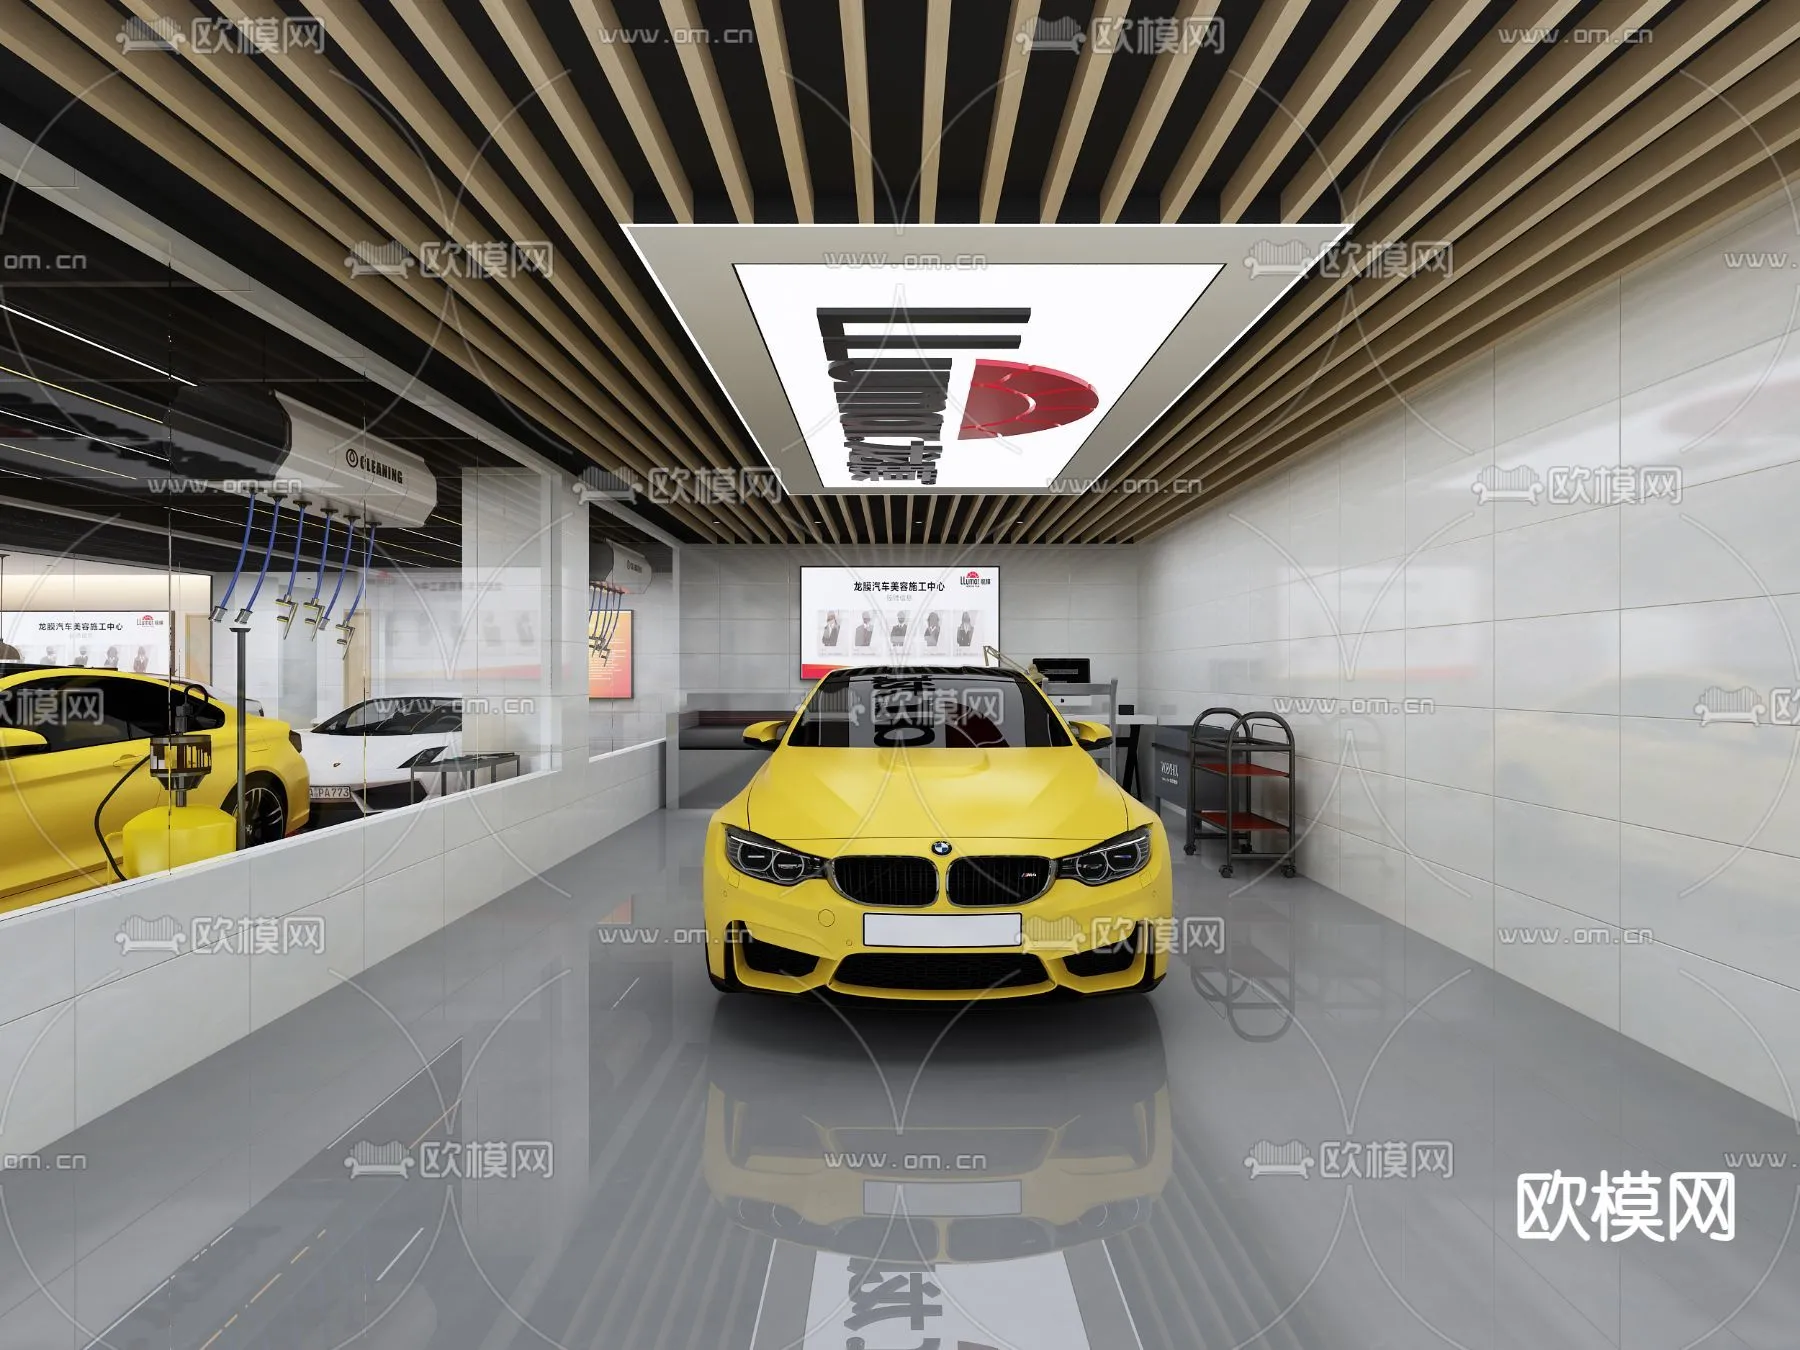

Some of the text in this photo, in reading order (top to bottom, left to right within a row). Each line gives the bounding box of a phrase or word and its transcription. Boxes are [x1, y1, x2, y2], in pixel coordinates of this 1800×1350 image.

[360, 456, 403, 484] CLEANING
[853, 581, 945, 592] 龙膜汽车美容施工中心
[38, 622, 124, 631] 龙膜汽车美容施工中心
